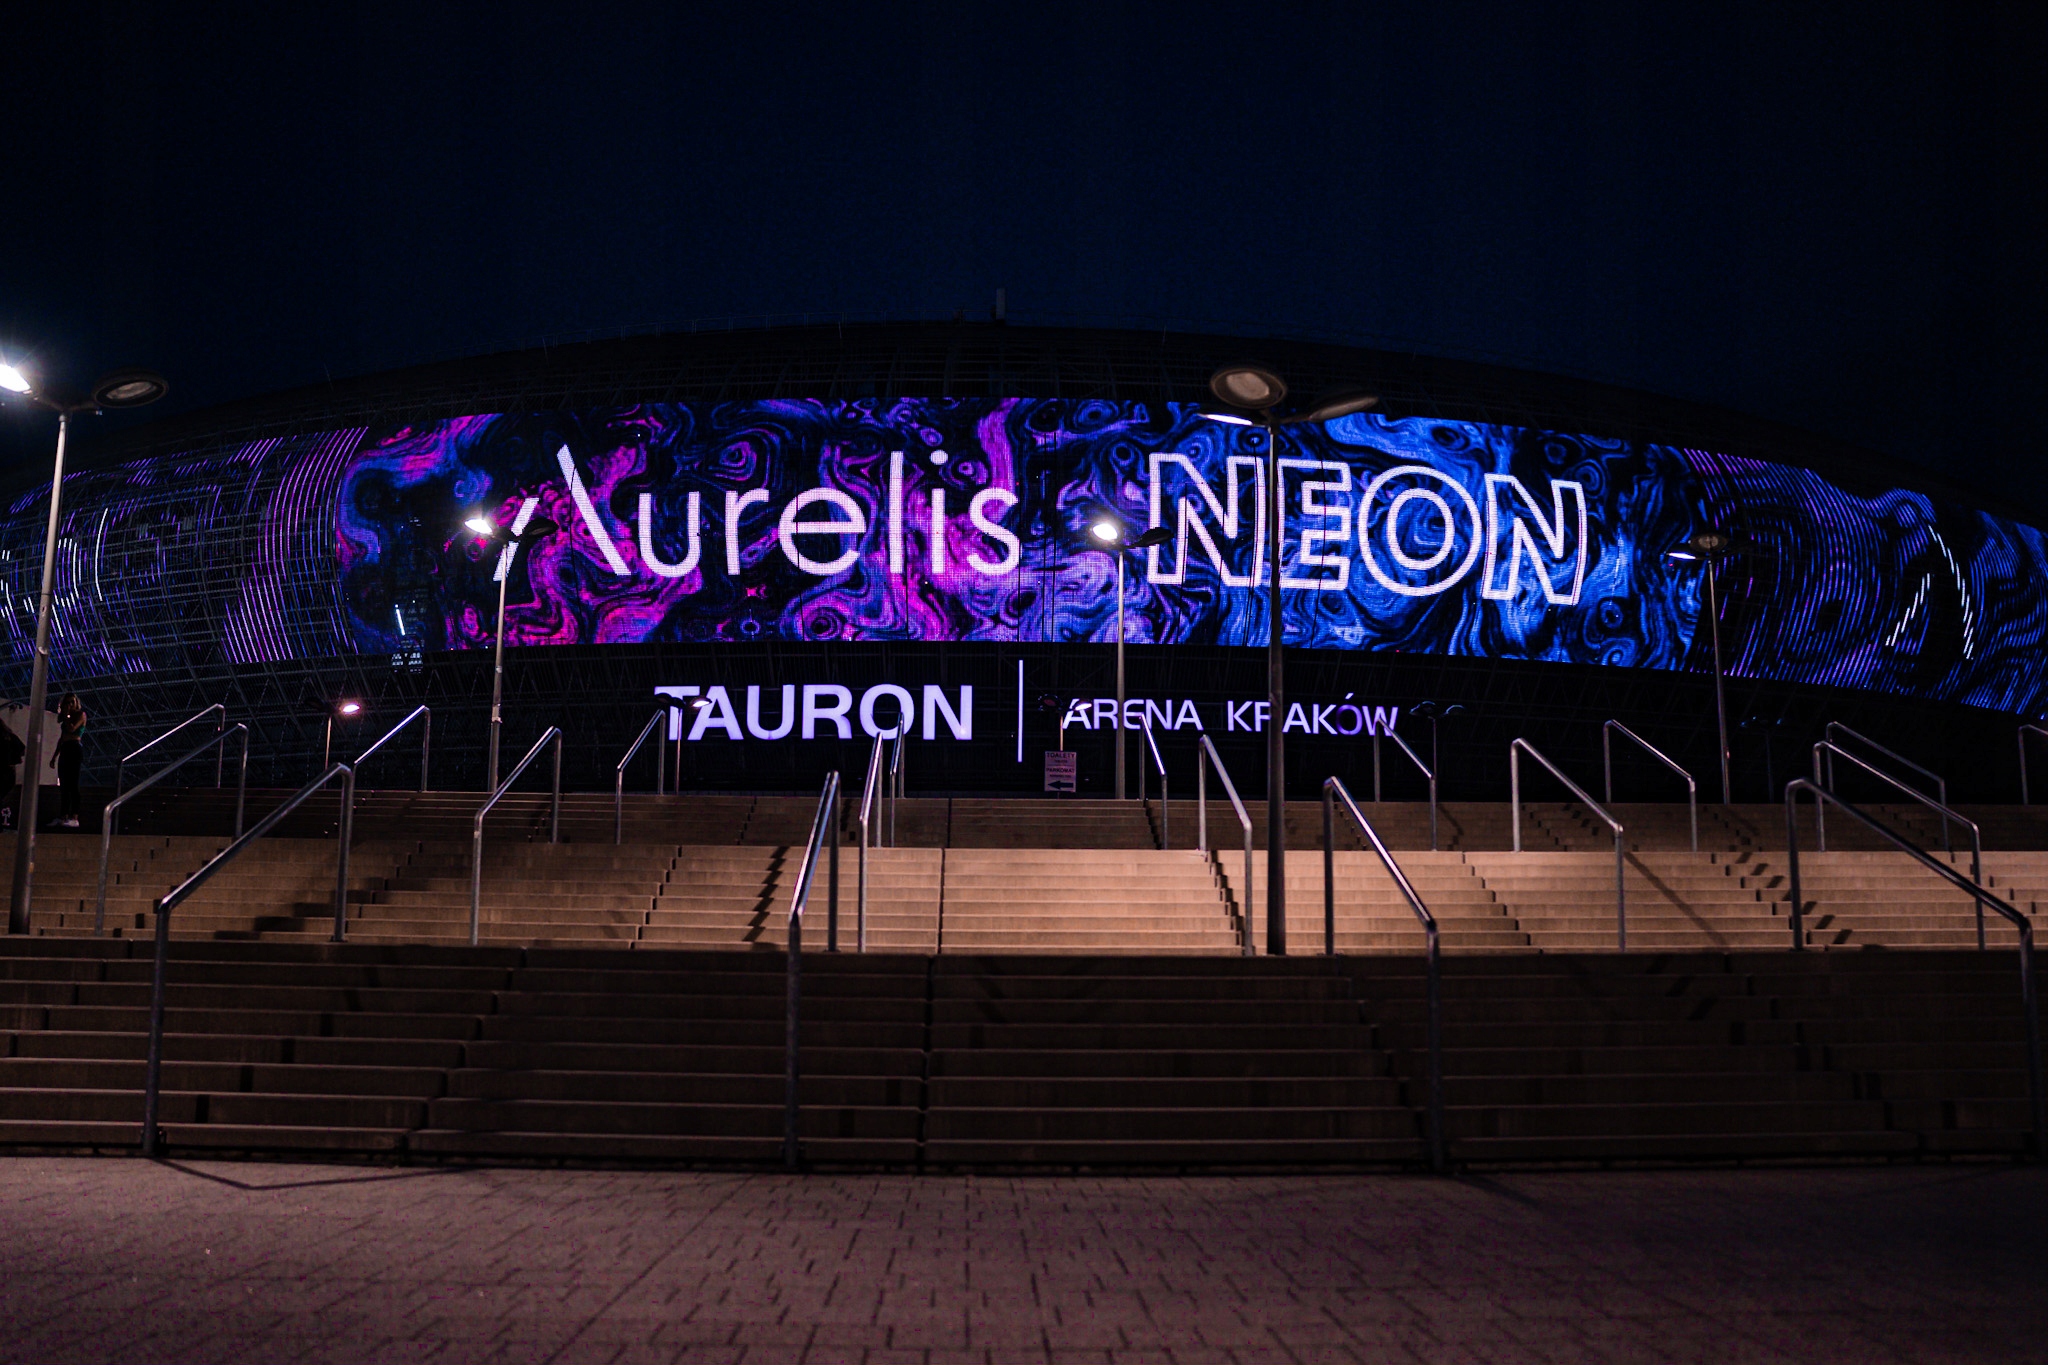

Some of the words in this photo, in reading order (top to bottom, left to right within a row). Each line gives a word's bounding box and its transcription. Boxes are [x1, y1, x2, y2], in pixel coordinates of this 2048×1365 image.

[493, 443, 1019, 581] Aurelis
[1147, 452, 1587, 605] NEON
[653, 683, 973, 741] TAURON
[1062, 697, 1204, 731] ARENA
